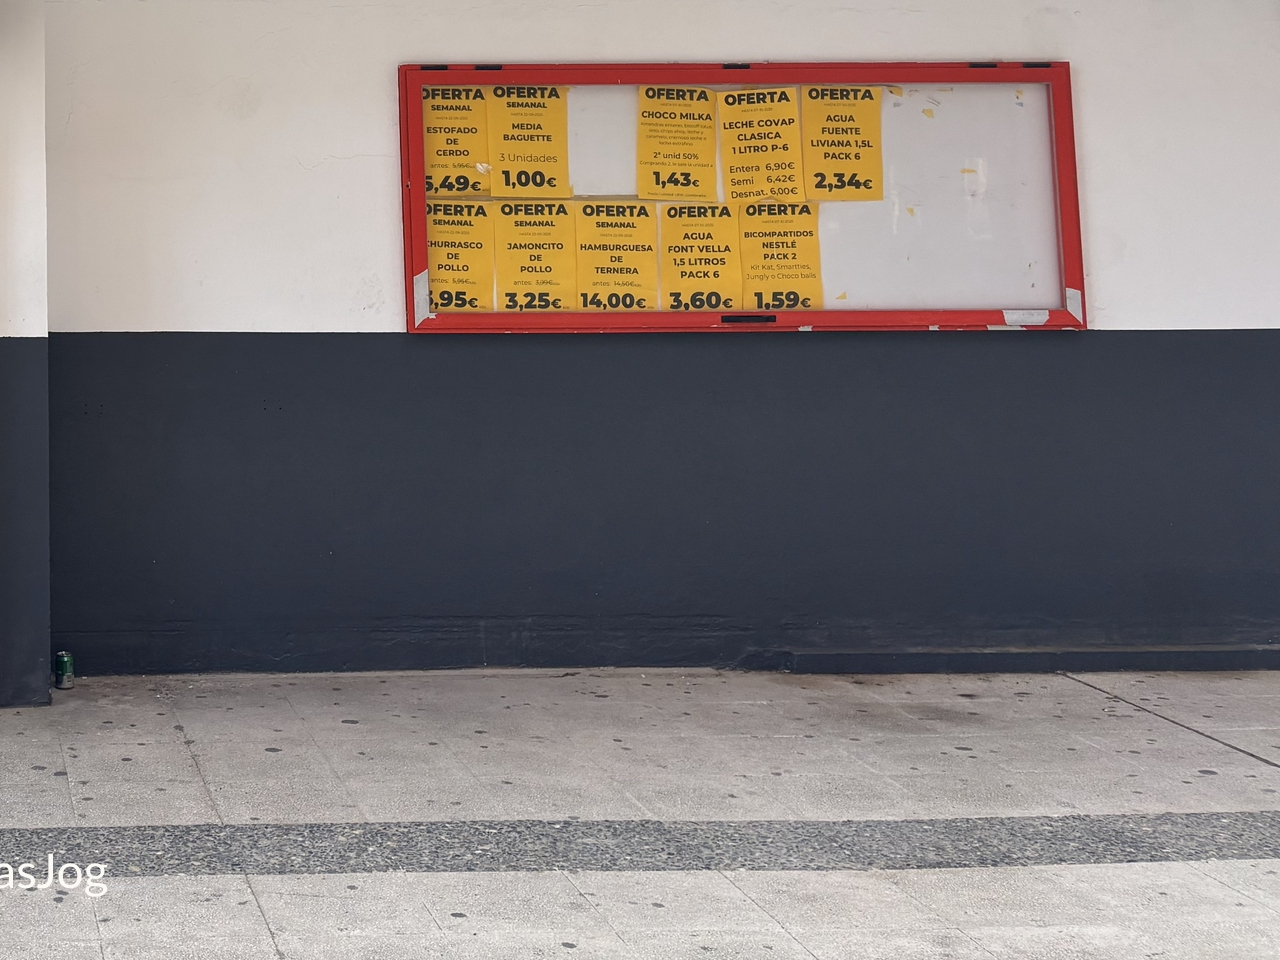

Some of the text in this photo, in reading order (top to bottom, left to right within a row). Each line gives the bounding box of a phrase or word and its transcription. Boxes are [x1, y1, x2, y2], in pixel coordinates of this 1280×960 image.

[493, 86, 560, 99] OFERTA
[645, 87, 709, 101] OFERTA
[724, 91, 790, 106] OFERTA
[808, 88, 874, 100] OFERTA
[641, 111, 712, 121] CHOCO MILKA
[723, 118, 795, 130] LECHE COVAP
[737, 131, 782, 142] CLASICA
[822, 127, 861, 135] FUENTE
[503, 134, 552, 142] BAGUETTE
[739, 145, 768, 154] LITRO
[772, 144, 789, 152] P-6
[811, 140, 873, 149] LIVIANA 1,5L
[499, 153, 558, 163] 3 Unidades
[824, 152, 852, 160] PACK
[730, 162, 795, 174] Entera 6,90€
[502, 170, 557, 189] 1,00€
[653, 171, 699, 189] 1,43€
[731, 175, 796, 186] Semi 6,42€
[814, 172, 873, 192] 2,34€
[731, 187, 798, 199] Desnat. 6,00€
[501, 203, 568, 216] OFERTA
[582, 205, 649, 218] OFERTA
[667, 206, 731, 218] OFERTA
[746, 204, 811, 216] OFERTA
[683, 232, 713, 240] AGUA
[580, 244, 653, 252] HAMBURGUESA
[698, 245, 731, 253] VELLA
[762, 240, 797, 249] NESTLÉ
[529, 254, 542, 262] DE
[673, 258, 726, 267] 1,5 LITROS
[681, 271, 720, 279] PACK 6
[505, 293, 562, 311] 3,25€
[580, 293, 646, 310] 14,00€
[669, 292, 733, 310] 3,60€
[754, 291, 811, 310] 1,59€
